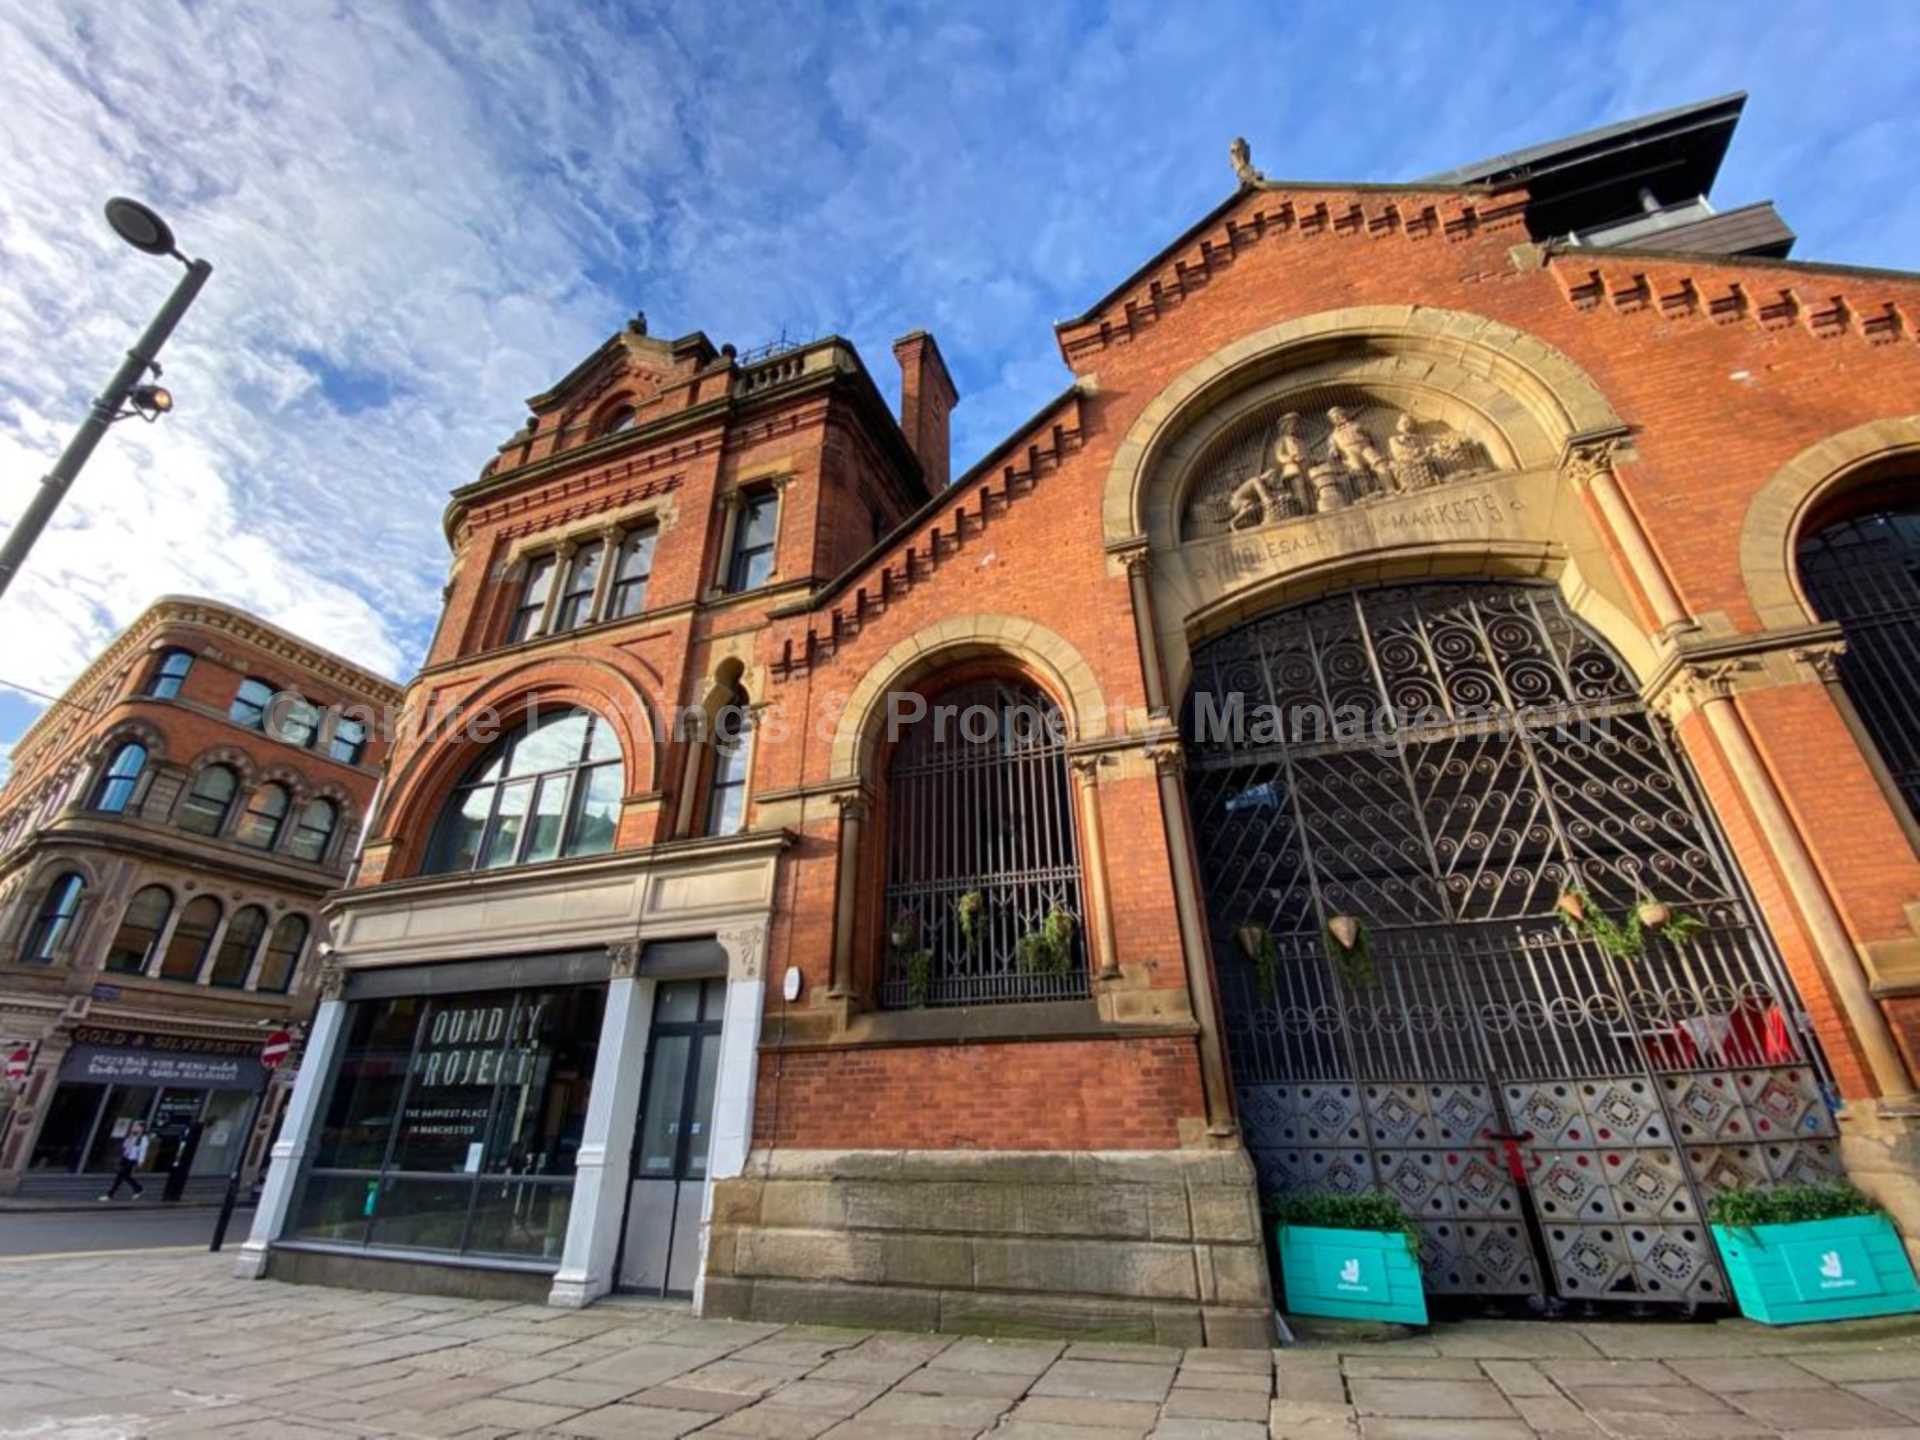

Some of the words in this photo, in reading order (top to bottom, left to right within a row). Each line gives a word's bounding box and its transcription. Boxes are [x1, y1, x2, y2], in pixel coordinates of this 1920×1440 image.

[1391, 494, 1504, 529] MARKETS
[76, 1028, 127, 1044] GOLD
[461, 1108, 488, 1118] PLACE
[420, 1125, 475, 1135] MANCHESTER
